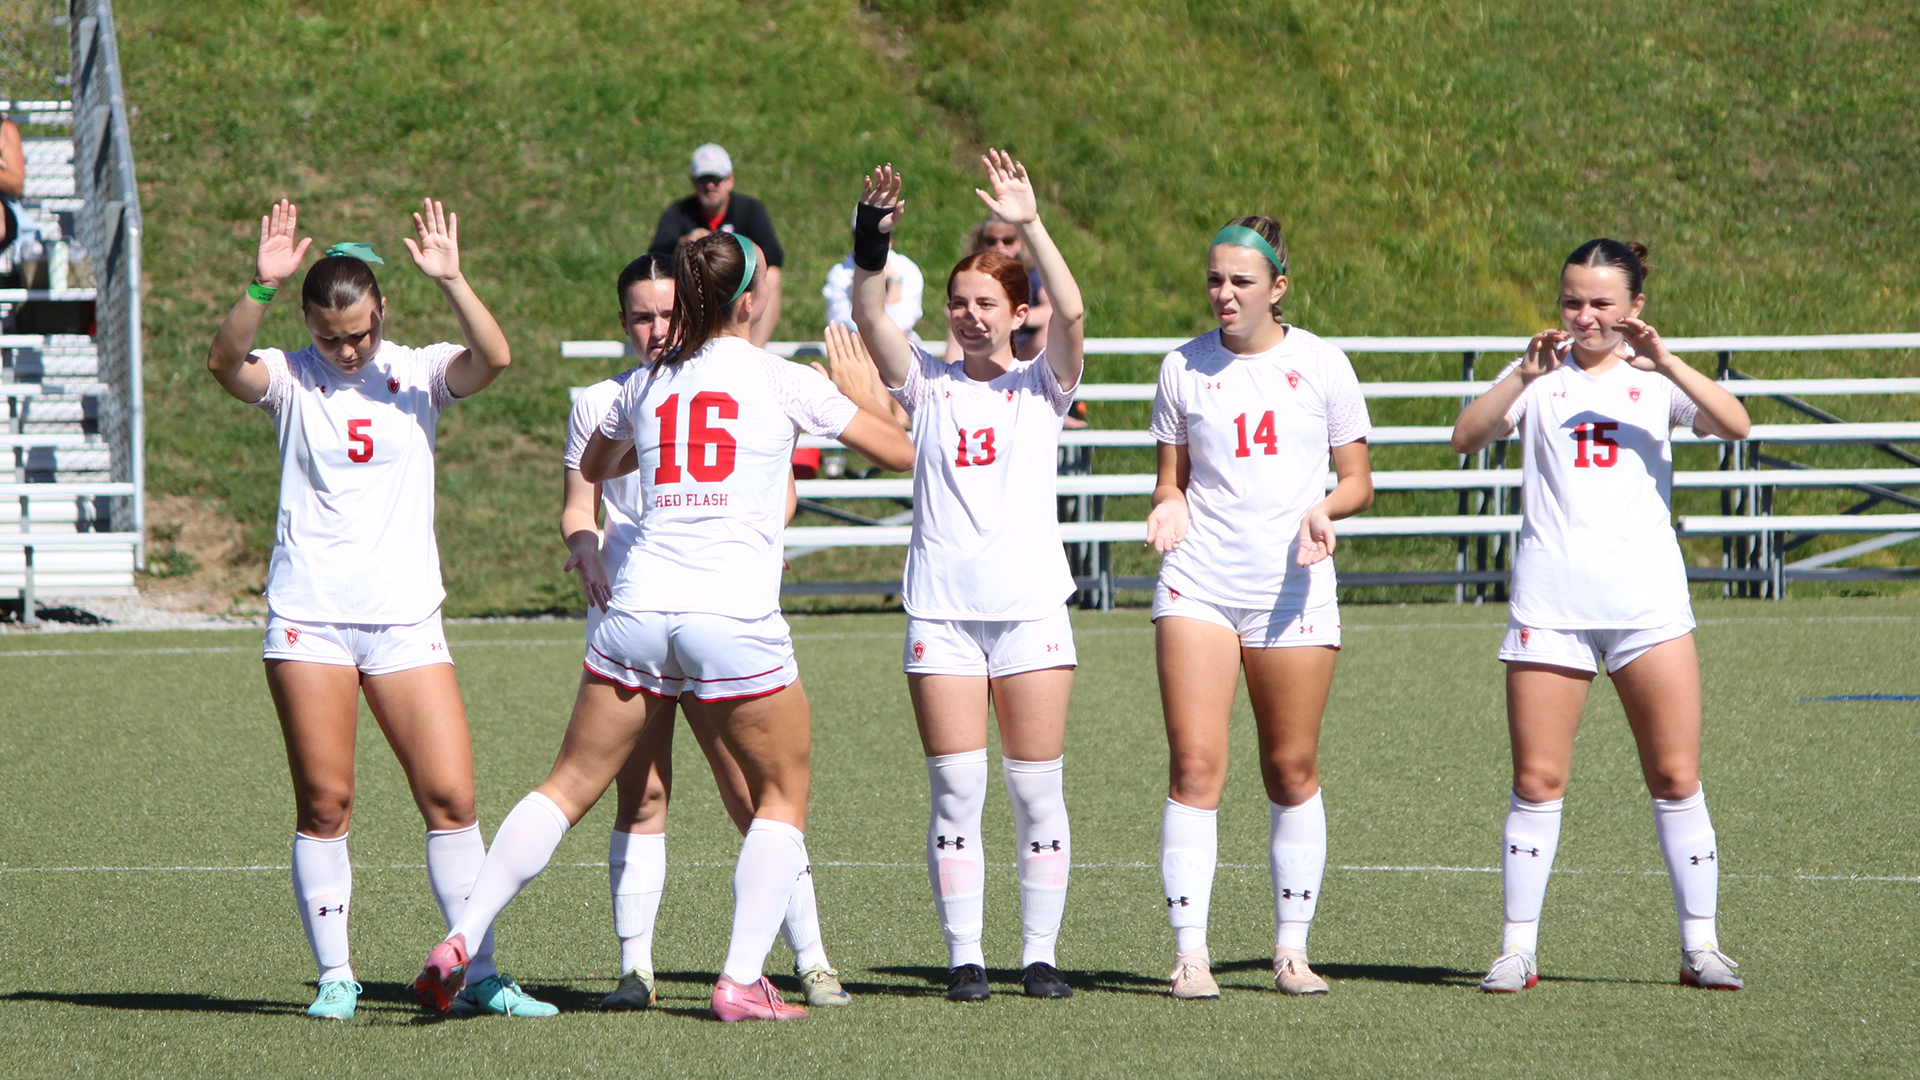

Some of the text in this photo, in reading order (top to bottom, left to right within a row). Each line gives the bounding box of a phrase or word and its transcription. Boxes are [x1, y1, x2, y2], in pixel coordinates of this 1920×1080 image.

[347, 418, 374, 463] 5
[654, 390, 739, 486] 16
[955, 427, 997, 468] 13
[1233, 410, 1278, 458] 14
[1574, 421, 1619, 468] 15
[655, 493, 729, 507] RED FLASH
